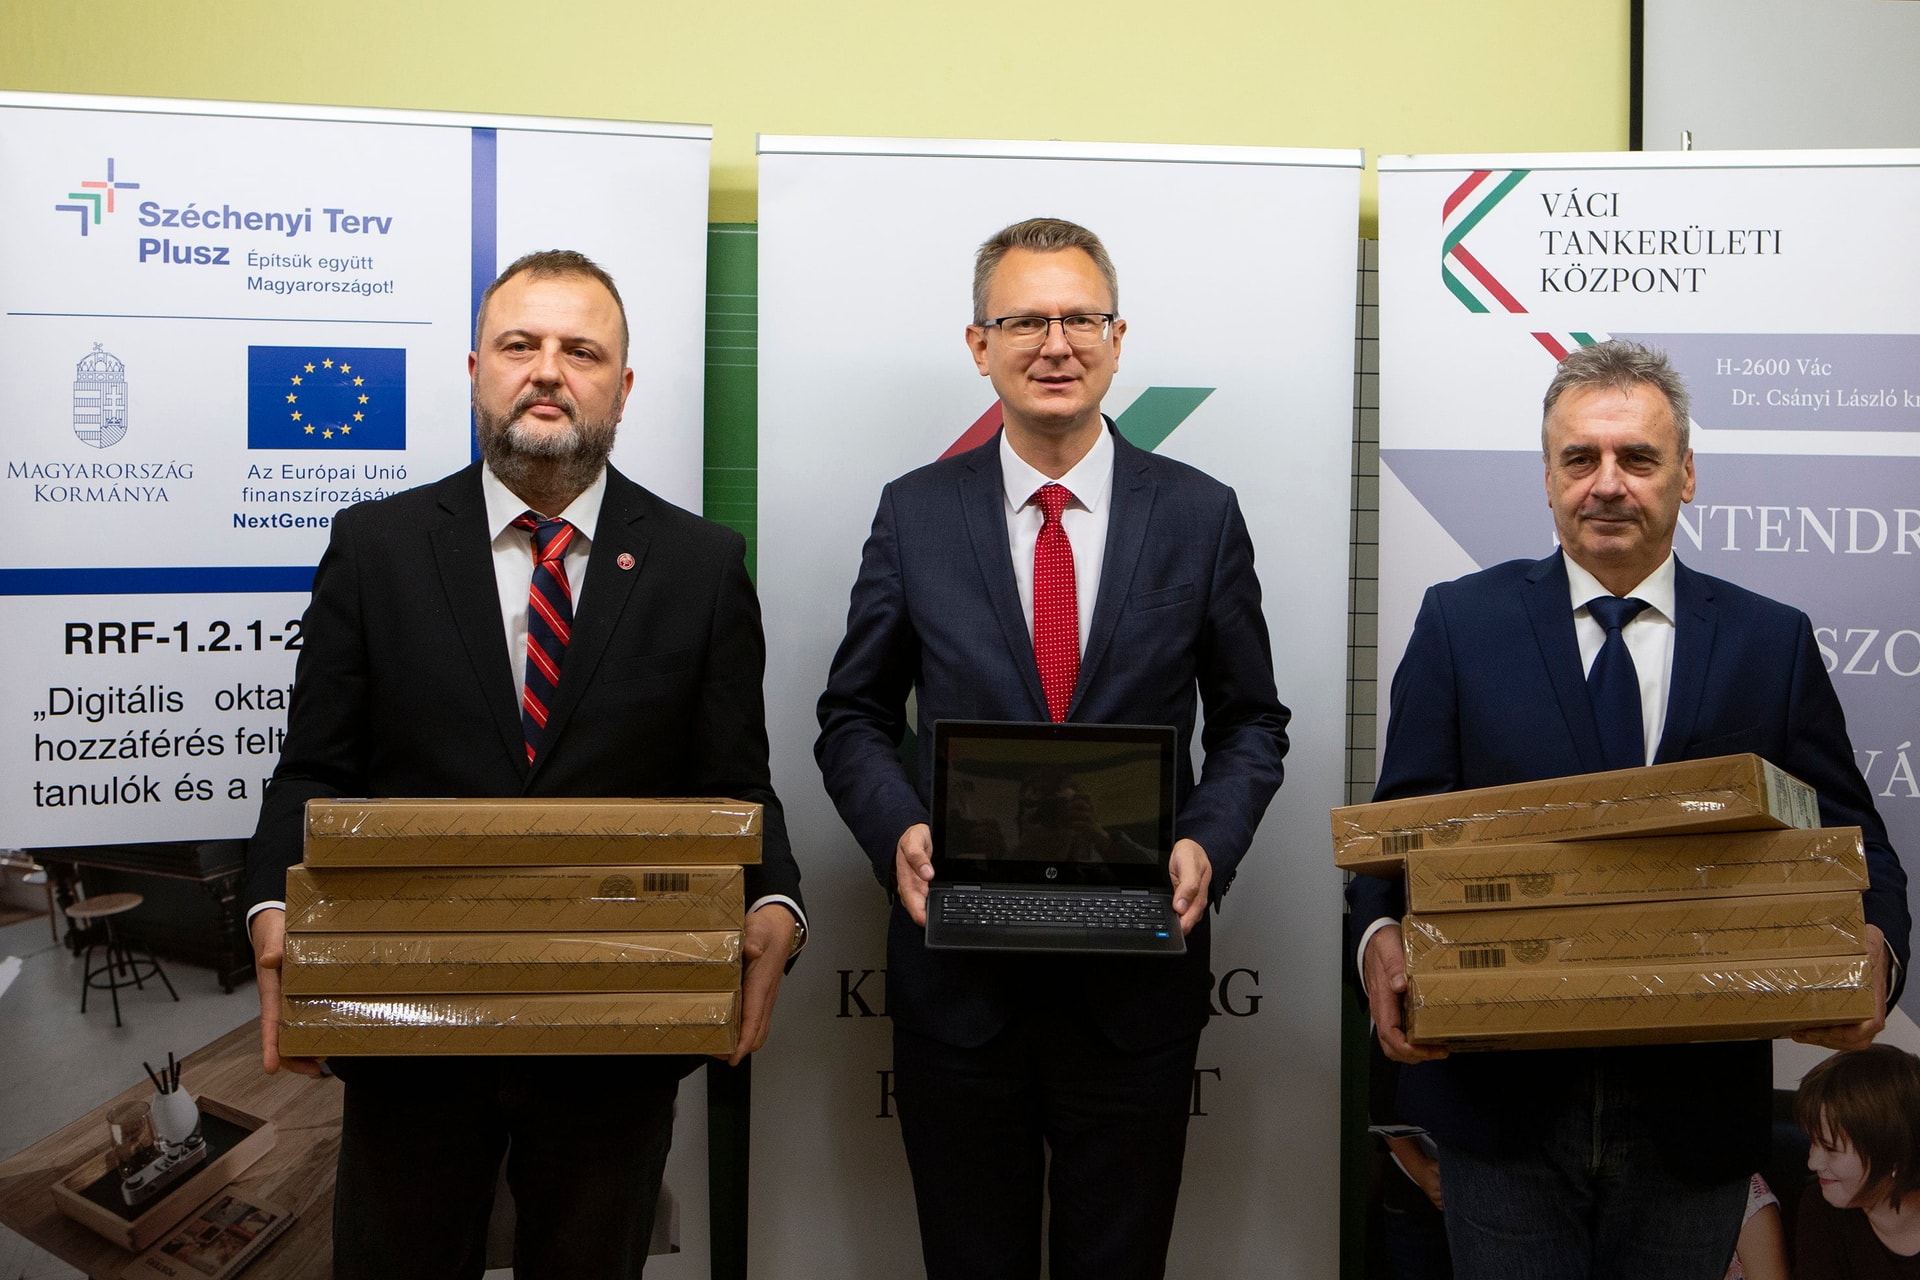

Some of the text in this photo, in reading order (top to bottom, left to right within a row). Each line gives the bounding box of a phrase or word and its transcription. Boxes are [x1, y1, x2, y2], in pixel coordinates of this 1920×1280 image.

[1541, 187, 1618, 218] VÁCI
[138, 201, 393, 238] Széchenyi Terv
[139, 237, 230, 266] Plusz
[1540, 224, 1781, 255] TANKERÜLETI
[247, 248, 374, 273] Építsük együtt
[247, 276, 394, 297] Magyarországot!
[1541, 262, 1707, 293] KÖZPONT
[1716, 357, 1832, 377] H-2600 Vác
[1732, 388, 1761, 406] Dr.
[1766, 387, 1830, 411] Csányi
[1837, 388, 1898, 408] László
[7, 460, 194, 480] MAGYARORSZÁG
[247, 464, 407, 484] Az Európai Unió
[35, 482, 169, 503] KORMÁNYA
[242, 486, 411, 503] finanszírozásáv
[233, 512, 333, 529] NextGene
[1552, 505, 1920, 555] NTENDR
[65, 620, 303, 655] RRF-1.2.1-2
[35, 727, 225, 762] hozzáférés
[33, 775, 161, 808] tanulók
[174, 772, 214, 802] és
[227, 778, 248, 800] a
